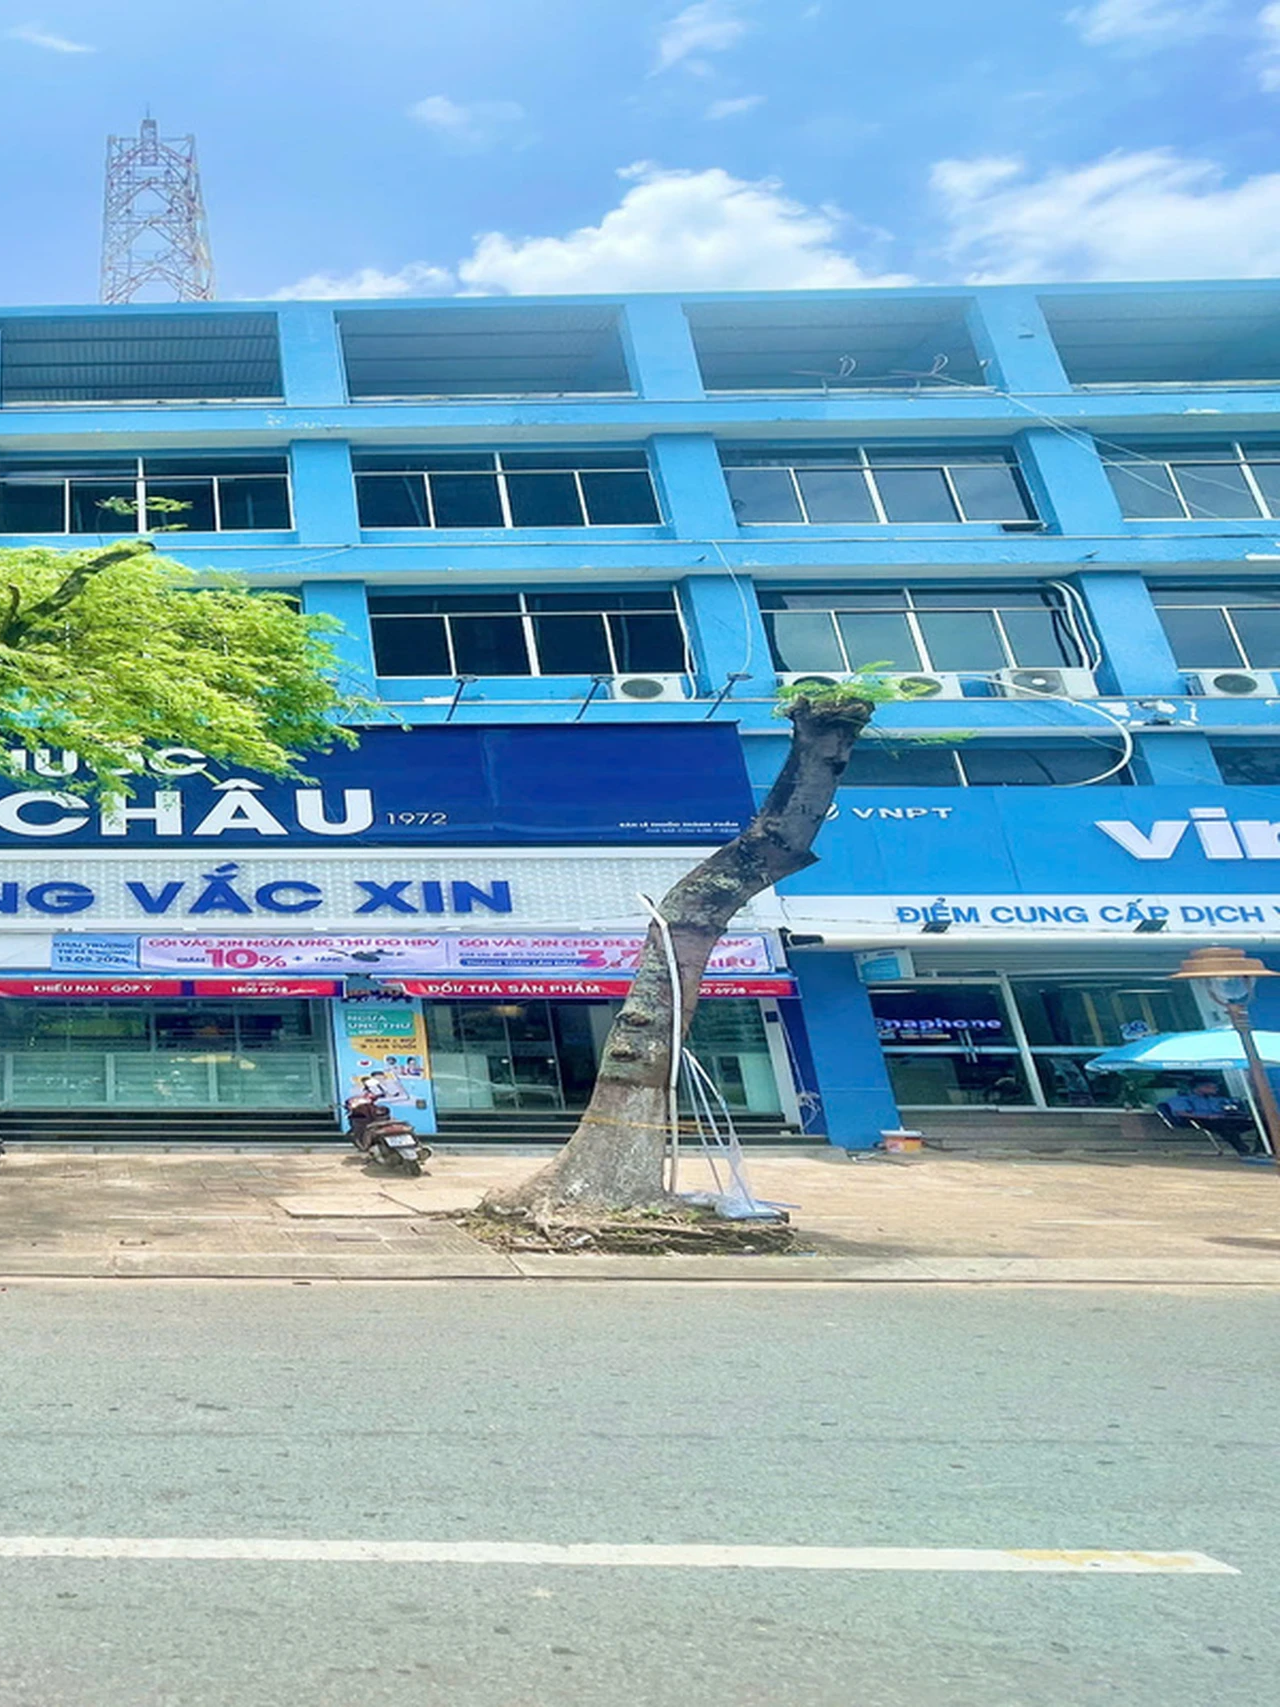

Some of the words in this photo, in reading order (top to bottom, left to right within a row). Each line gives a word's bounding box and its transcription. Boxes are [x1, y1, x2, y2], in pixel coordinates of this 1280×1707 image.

[386, 811, 448, 825] 1972
[852, 806, 953, 820] VNPT
[126, 863, 323, 914] VẮC
[354, 880, 513, 914] XIN
[896, 898, 980, 924] ĐIỂM
[990, 906, 1089, 923] CUNG
[1099, 898, 1170, 923] CẤP
[1180, 906, 1265, 926] DỊCH
[216, 938, 244, 948] XIN
[404, 938, 439, 948] HPV
[531, 938, 559, 948] XIN
[561, 938, 600, 948] CHO
